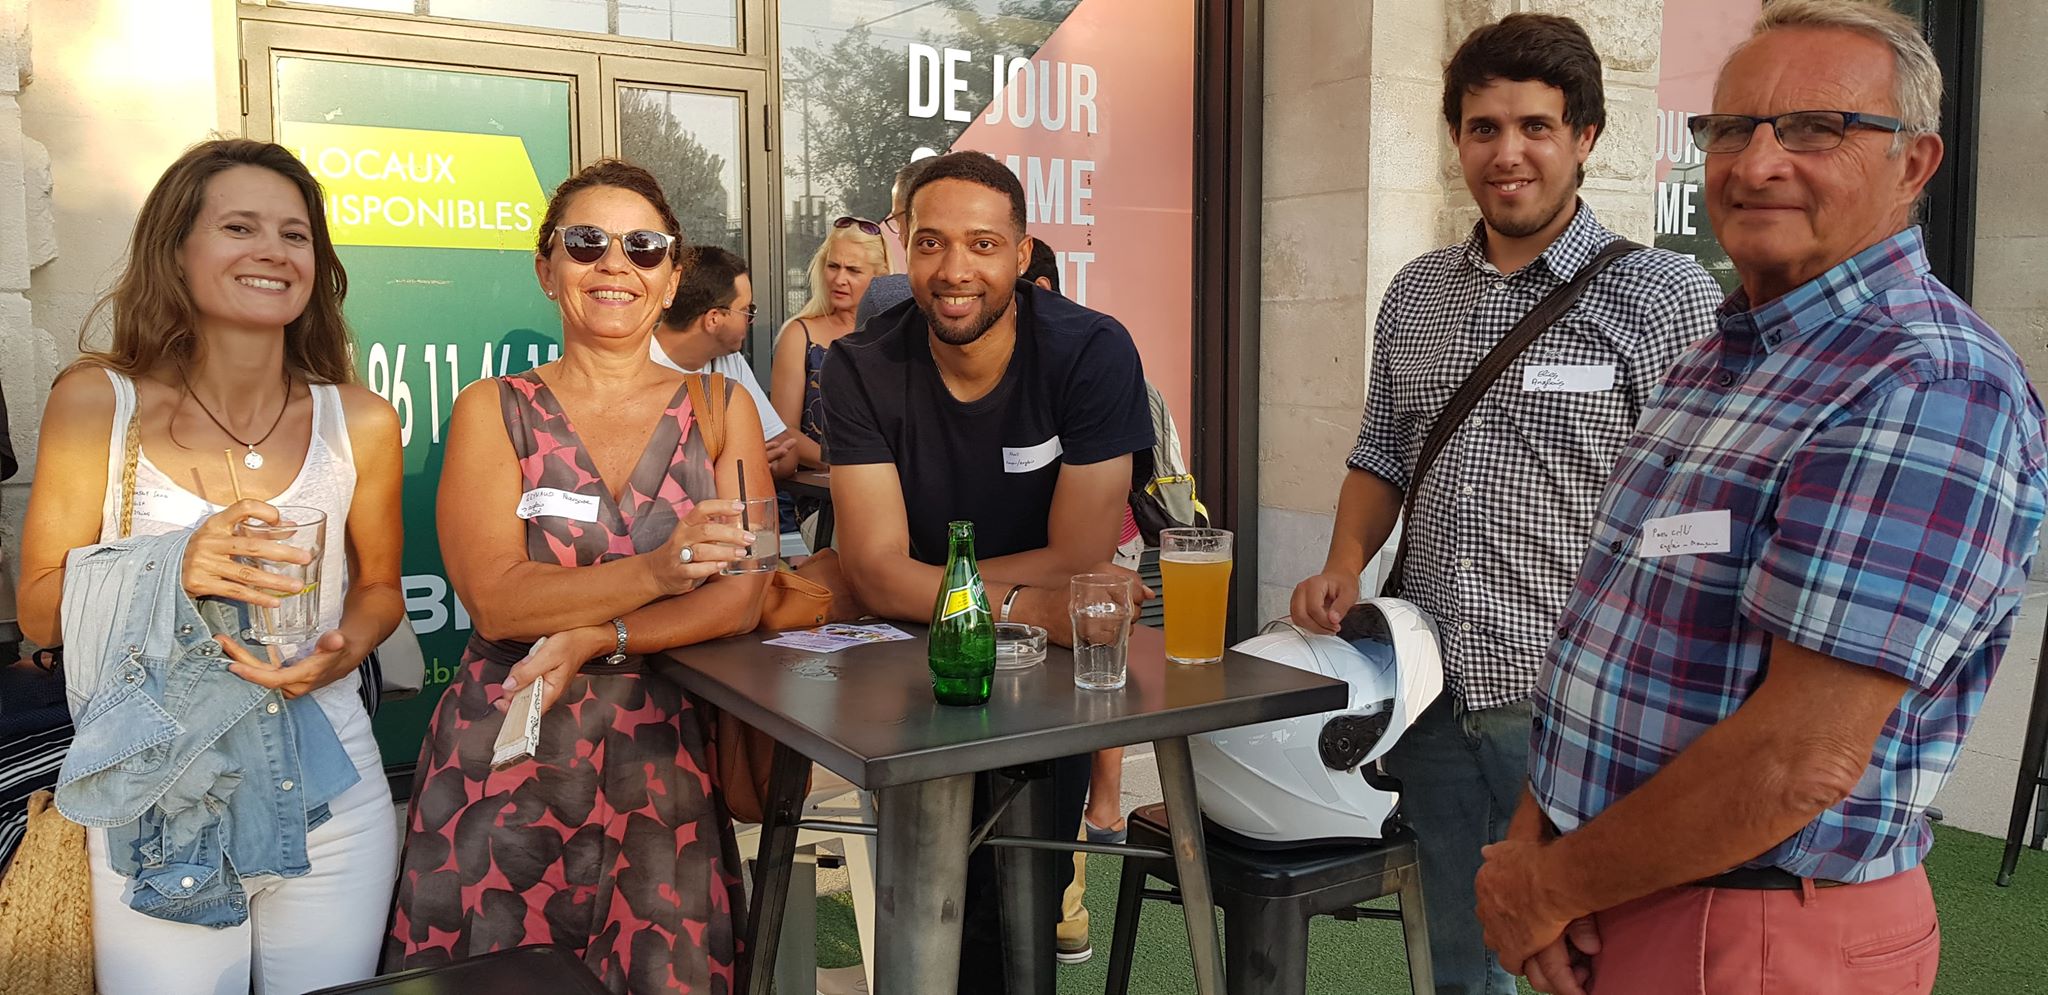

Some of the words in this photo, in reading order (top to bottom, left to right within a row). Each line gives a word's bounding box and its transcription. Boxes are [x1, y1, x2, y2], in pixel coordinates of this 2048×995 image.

[908, 43, 971, 122] DE
[985, 54, 1098, 134] JOUR
[323, 194, 532, 231] ISPONIBLES
[1653, 181, 1698, 236] ME
[368, 342, 413, 448] 96
